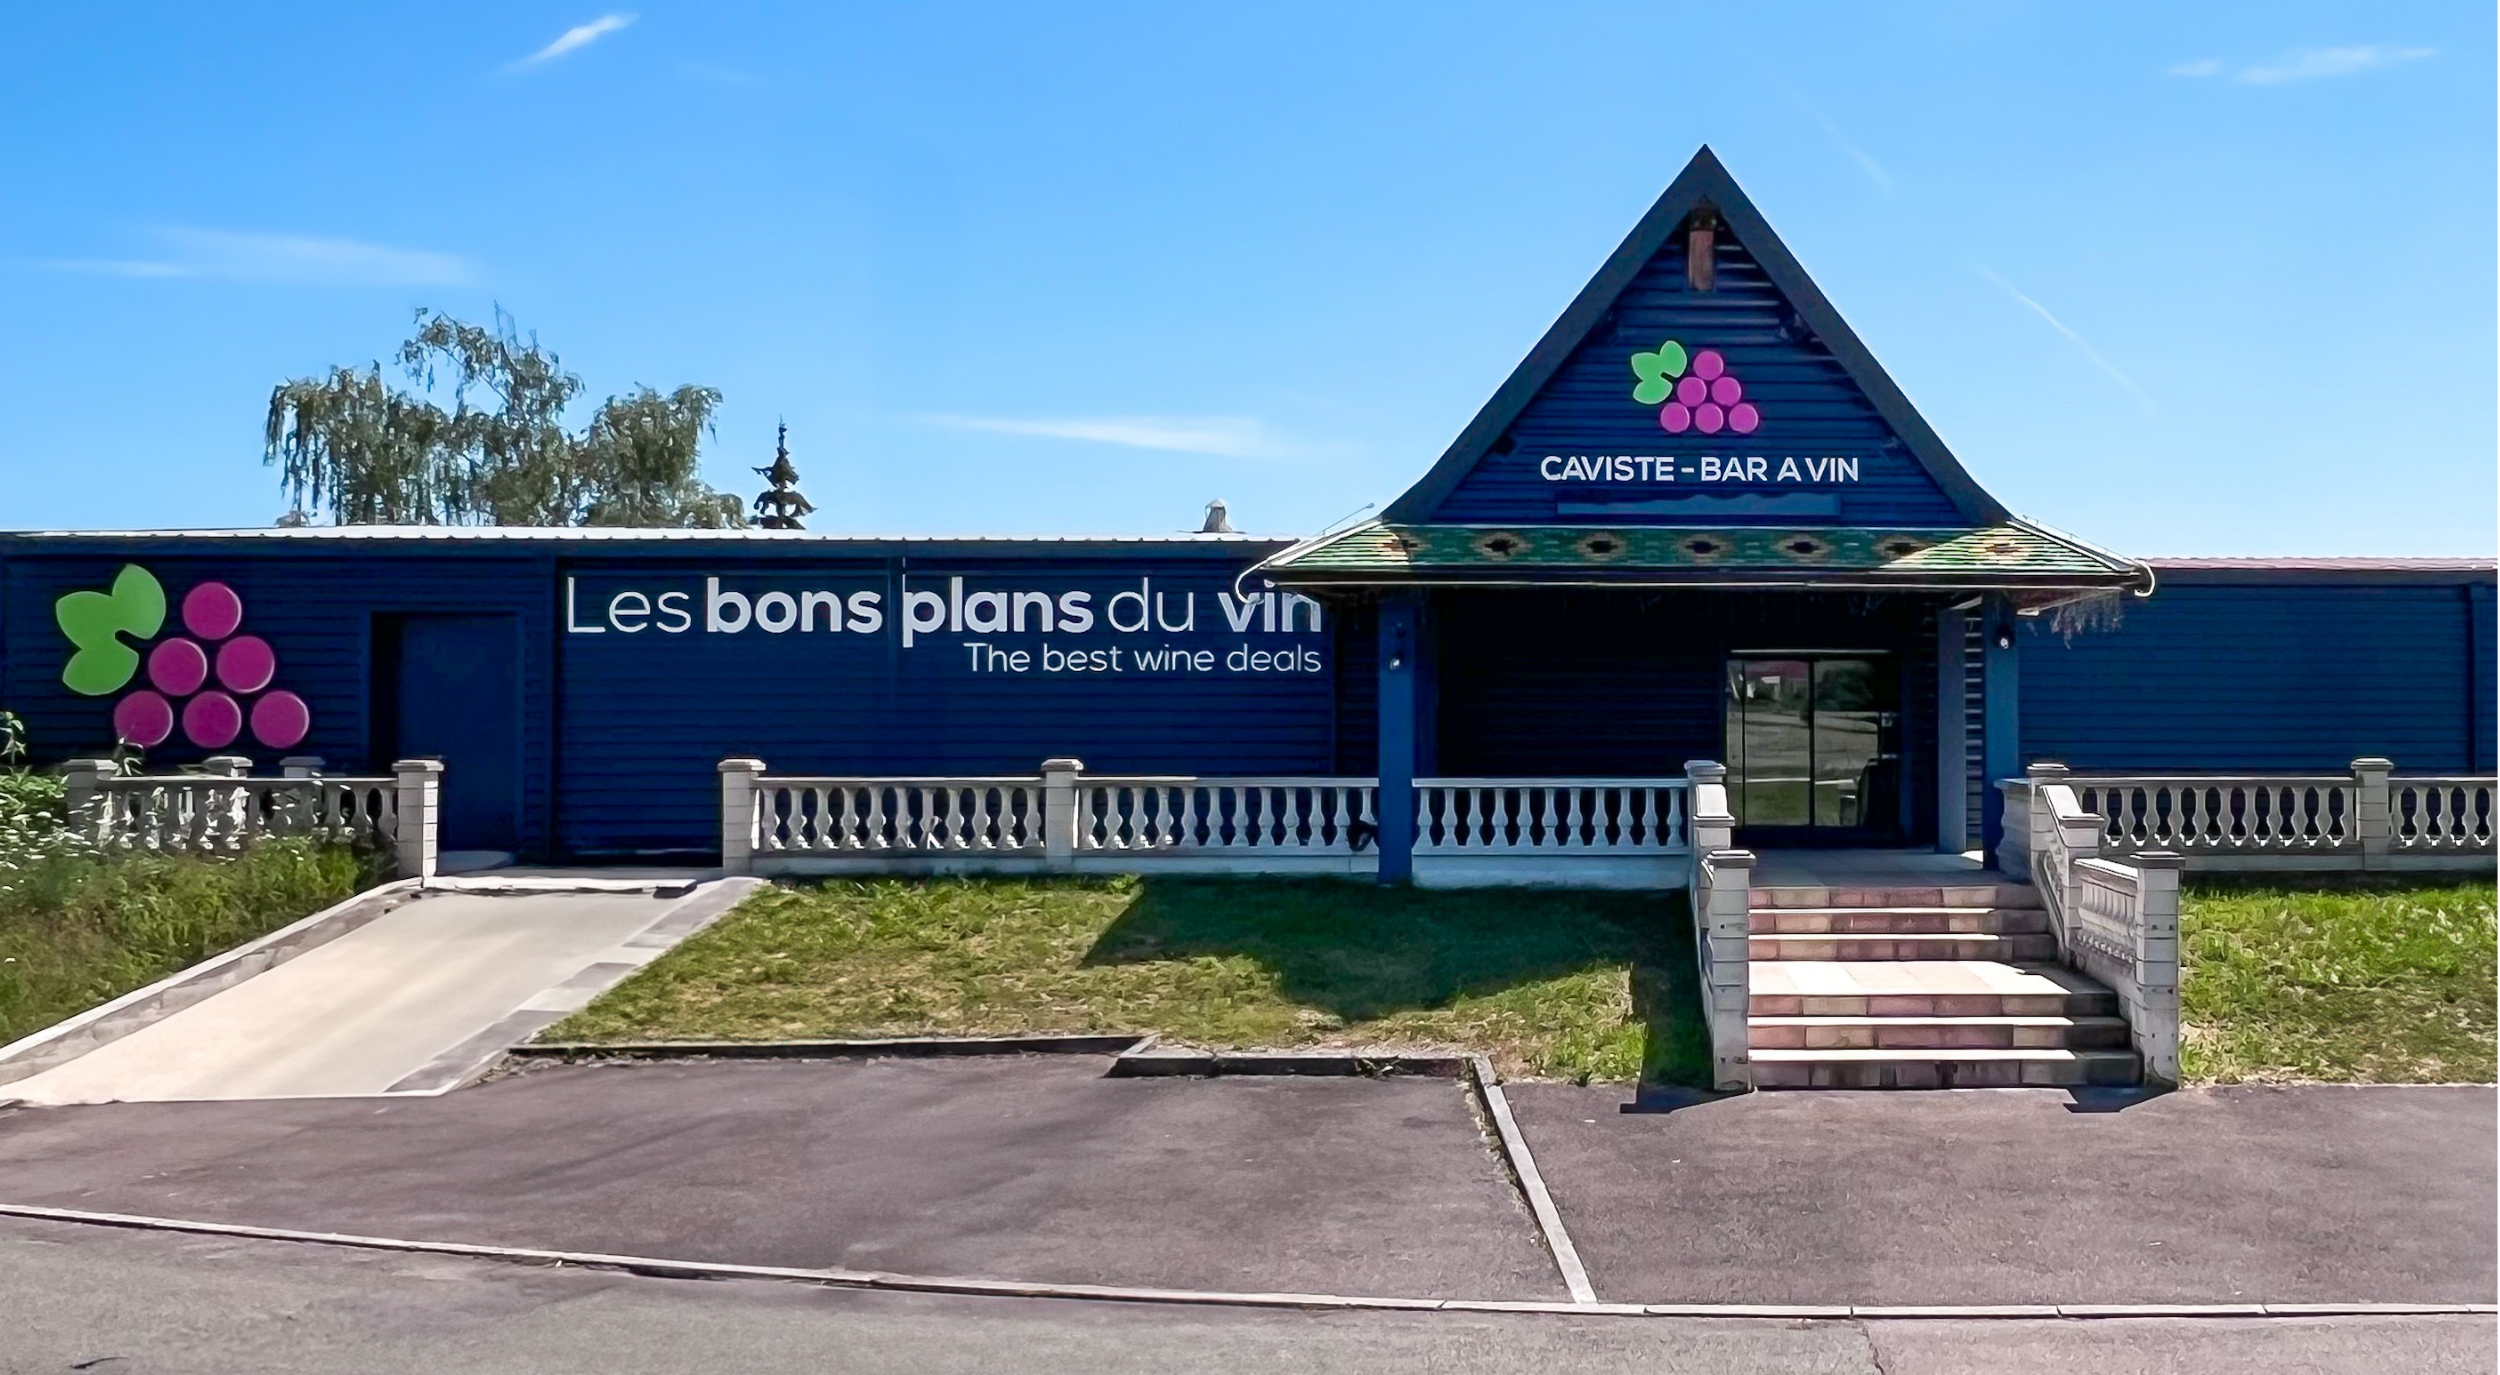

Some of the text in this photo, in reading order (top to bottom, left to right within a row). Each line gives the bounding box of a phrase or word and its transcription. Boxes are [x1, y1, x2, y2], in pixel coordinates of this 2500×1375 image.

[1540, 455, 1675, 482] CAVISTE
[1701, 456, 1768, 482] BAR
[1777, 456, 1802, 482] A
[1804, 456, 1859, 482] VIN
[567, 576, 692, 633] Les
[706, 576, 883, 634] bons
[902, 575, 1095, 648] plans
[1107, 576, 1194, 633] du
[963, 642, 1322, 673] The best wine deals
